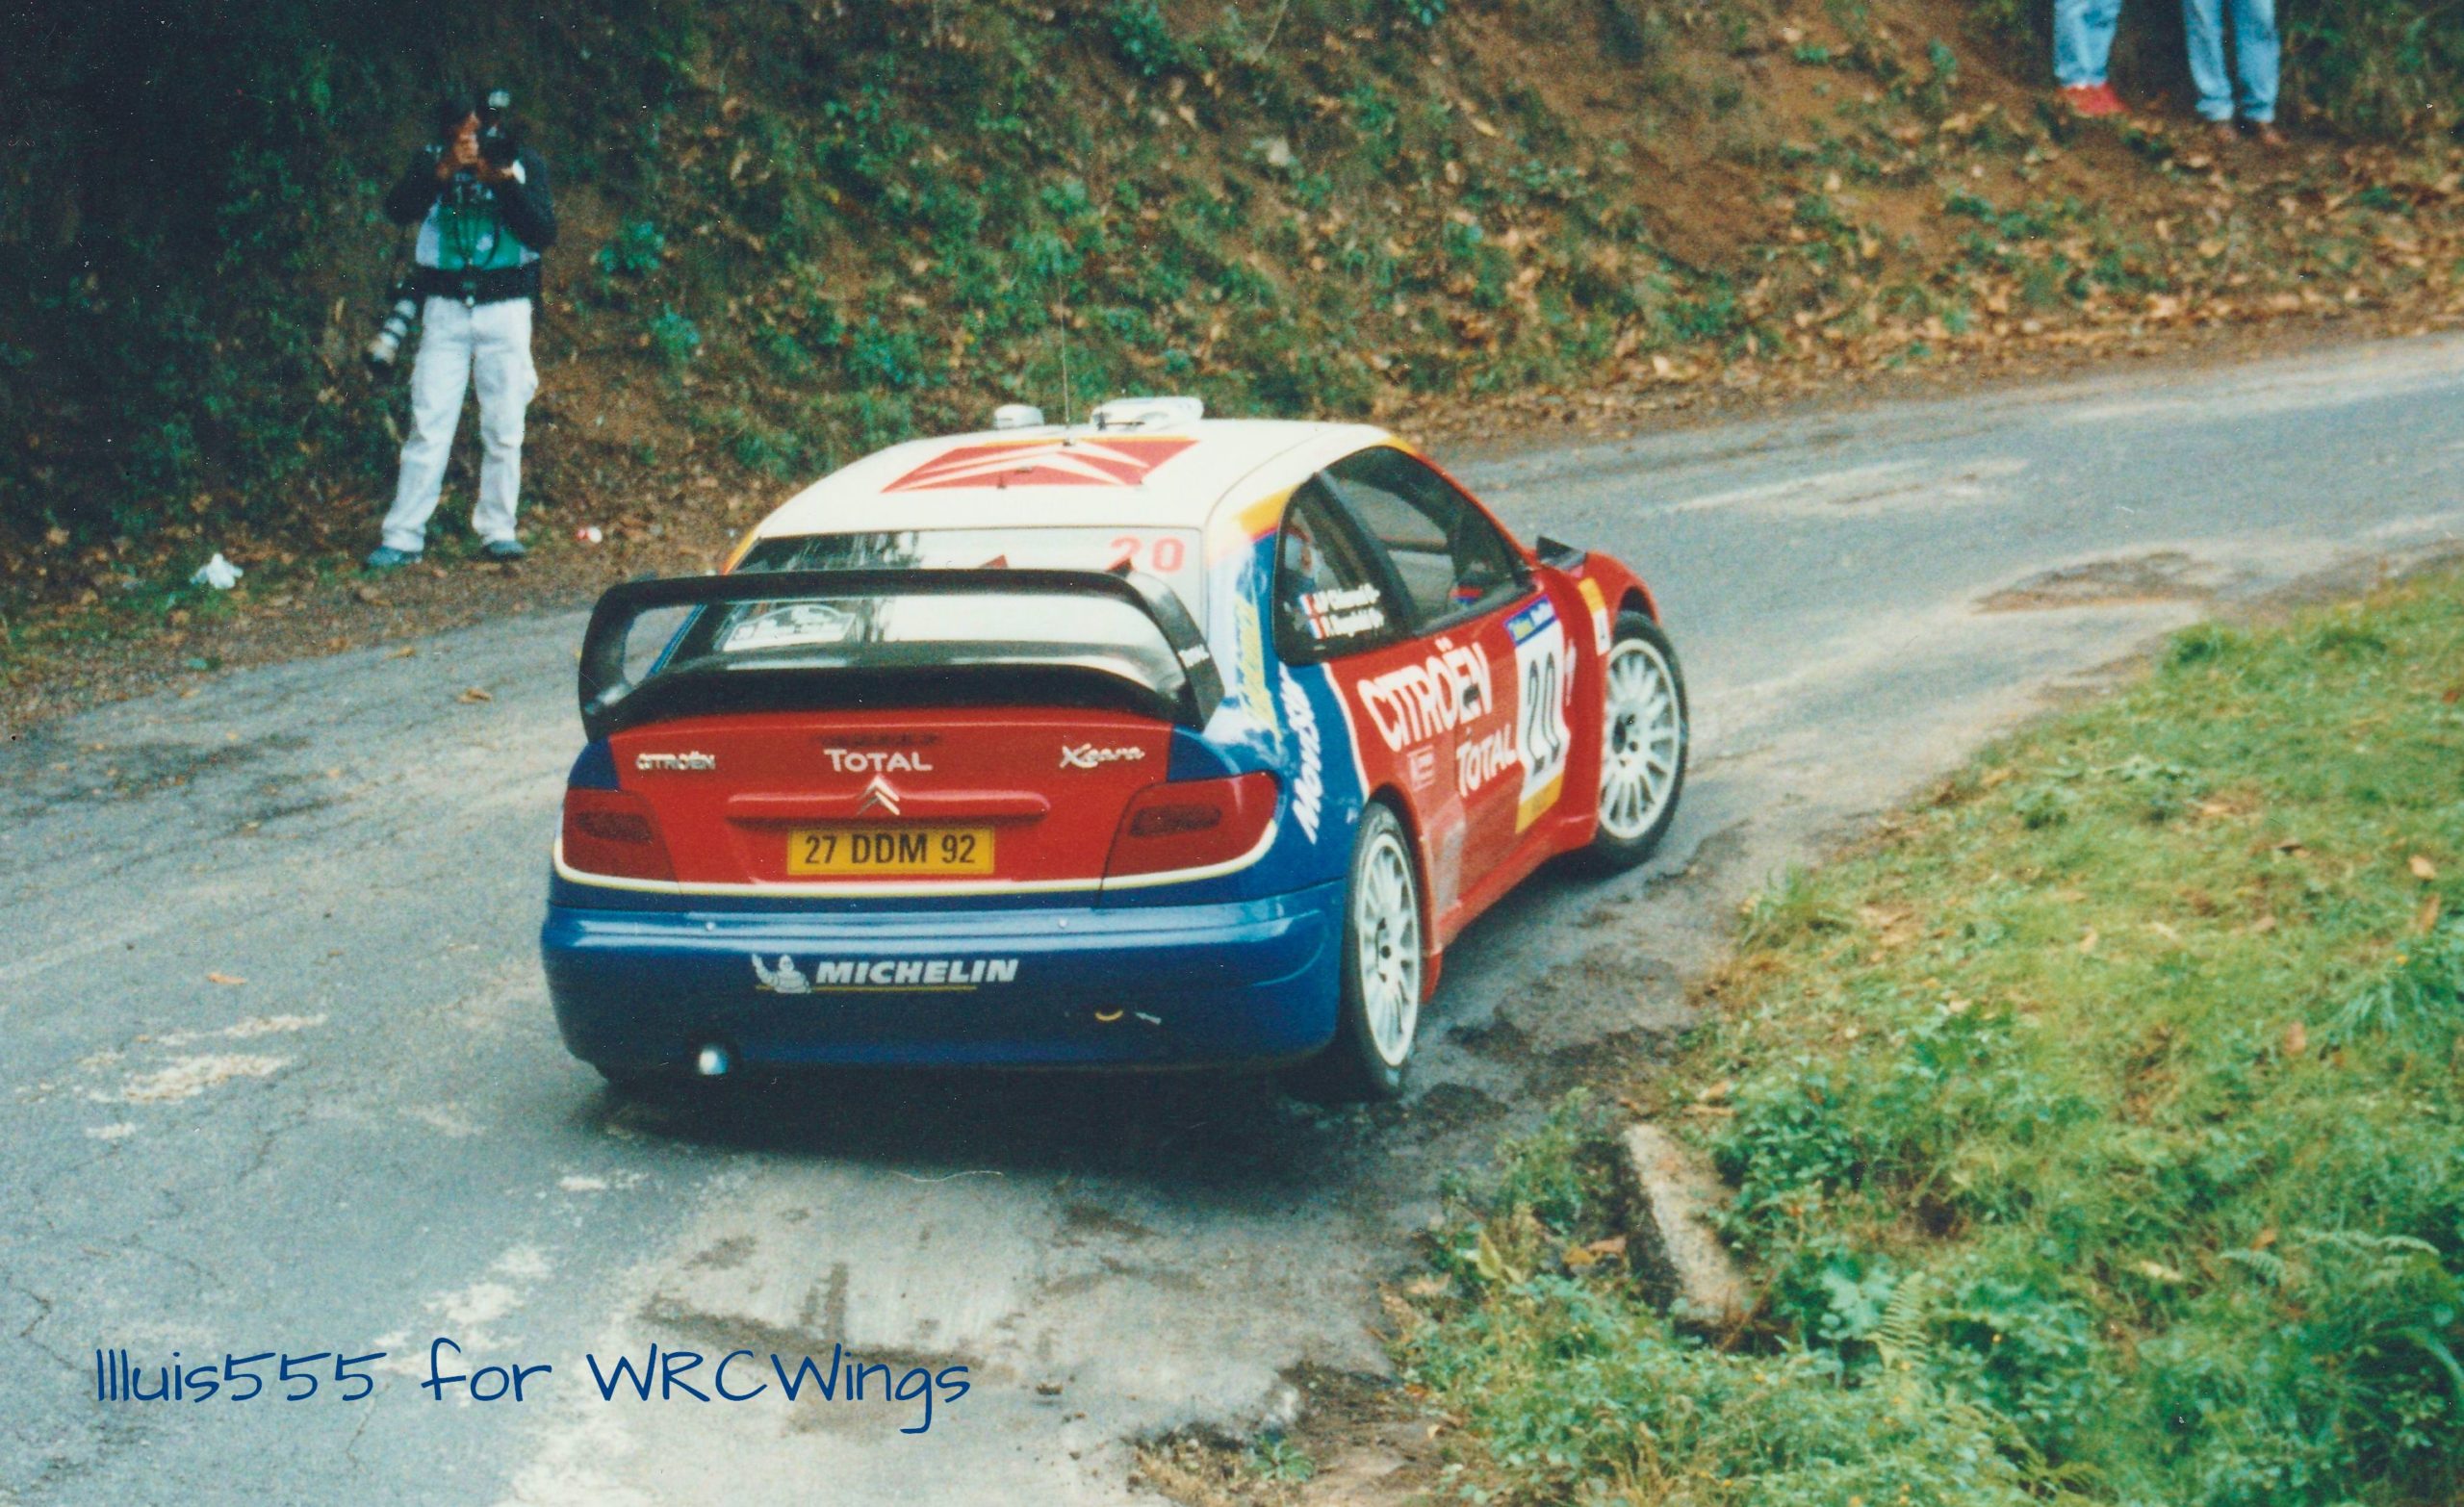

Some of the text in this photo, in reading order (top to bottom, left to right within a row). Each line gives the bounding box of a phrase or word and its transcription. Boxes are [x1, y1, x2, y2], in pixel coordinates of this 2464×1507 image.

[1110, 535, 1186, 573] 20
[1357, 636, 1492, 752] CITROËN
[823, 749, 934, 773] TOTAL
[1456, 723, 1519, 798] TOTAL
[805, 832, 976, 864] 27 DDM 92
[815, 958, 1019, 984] MICHELIN
